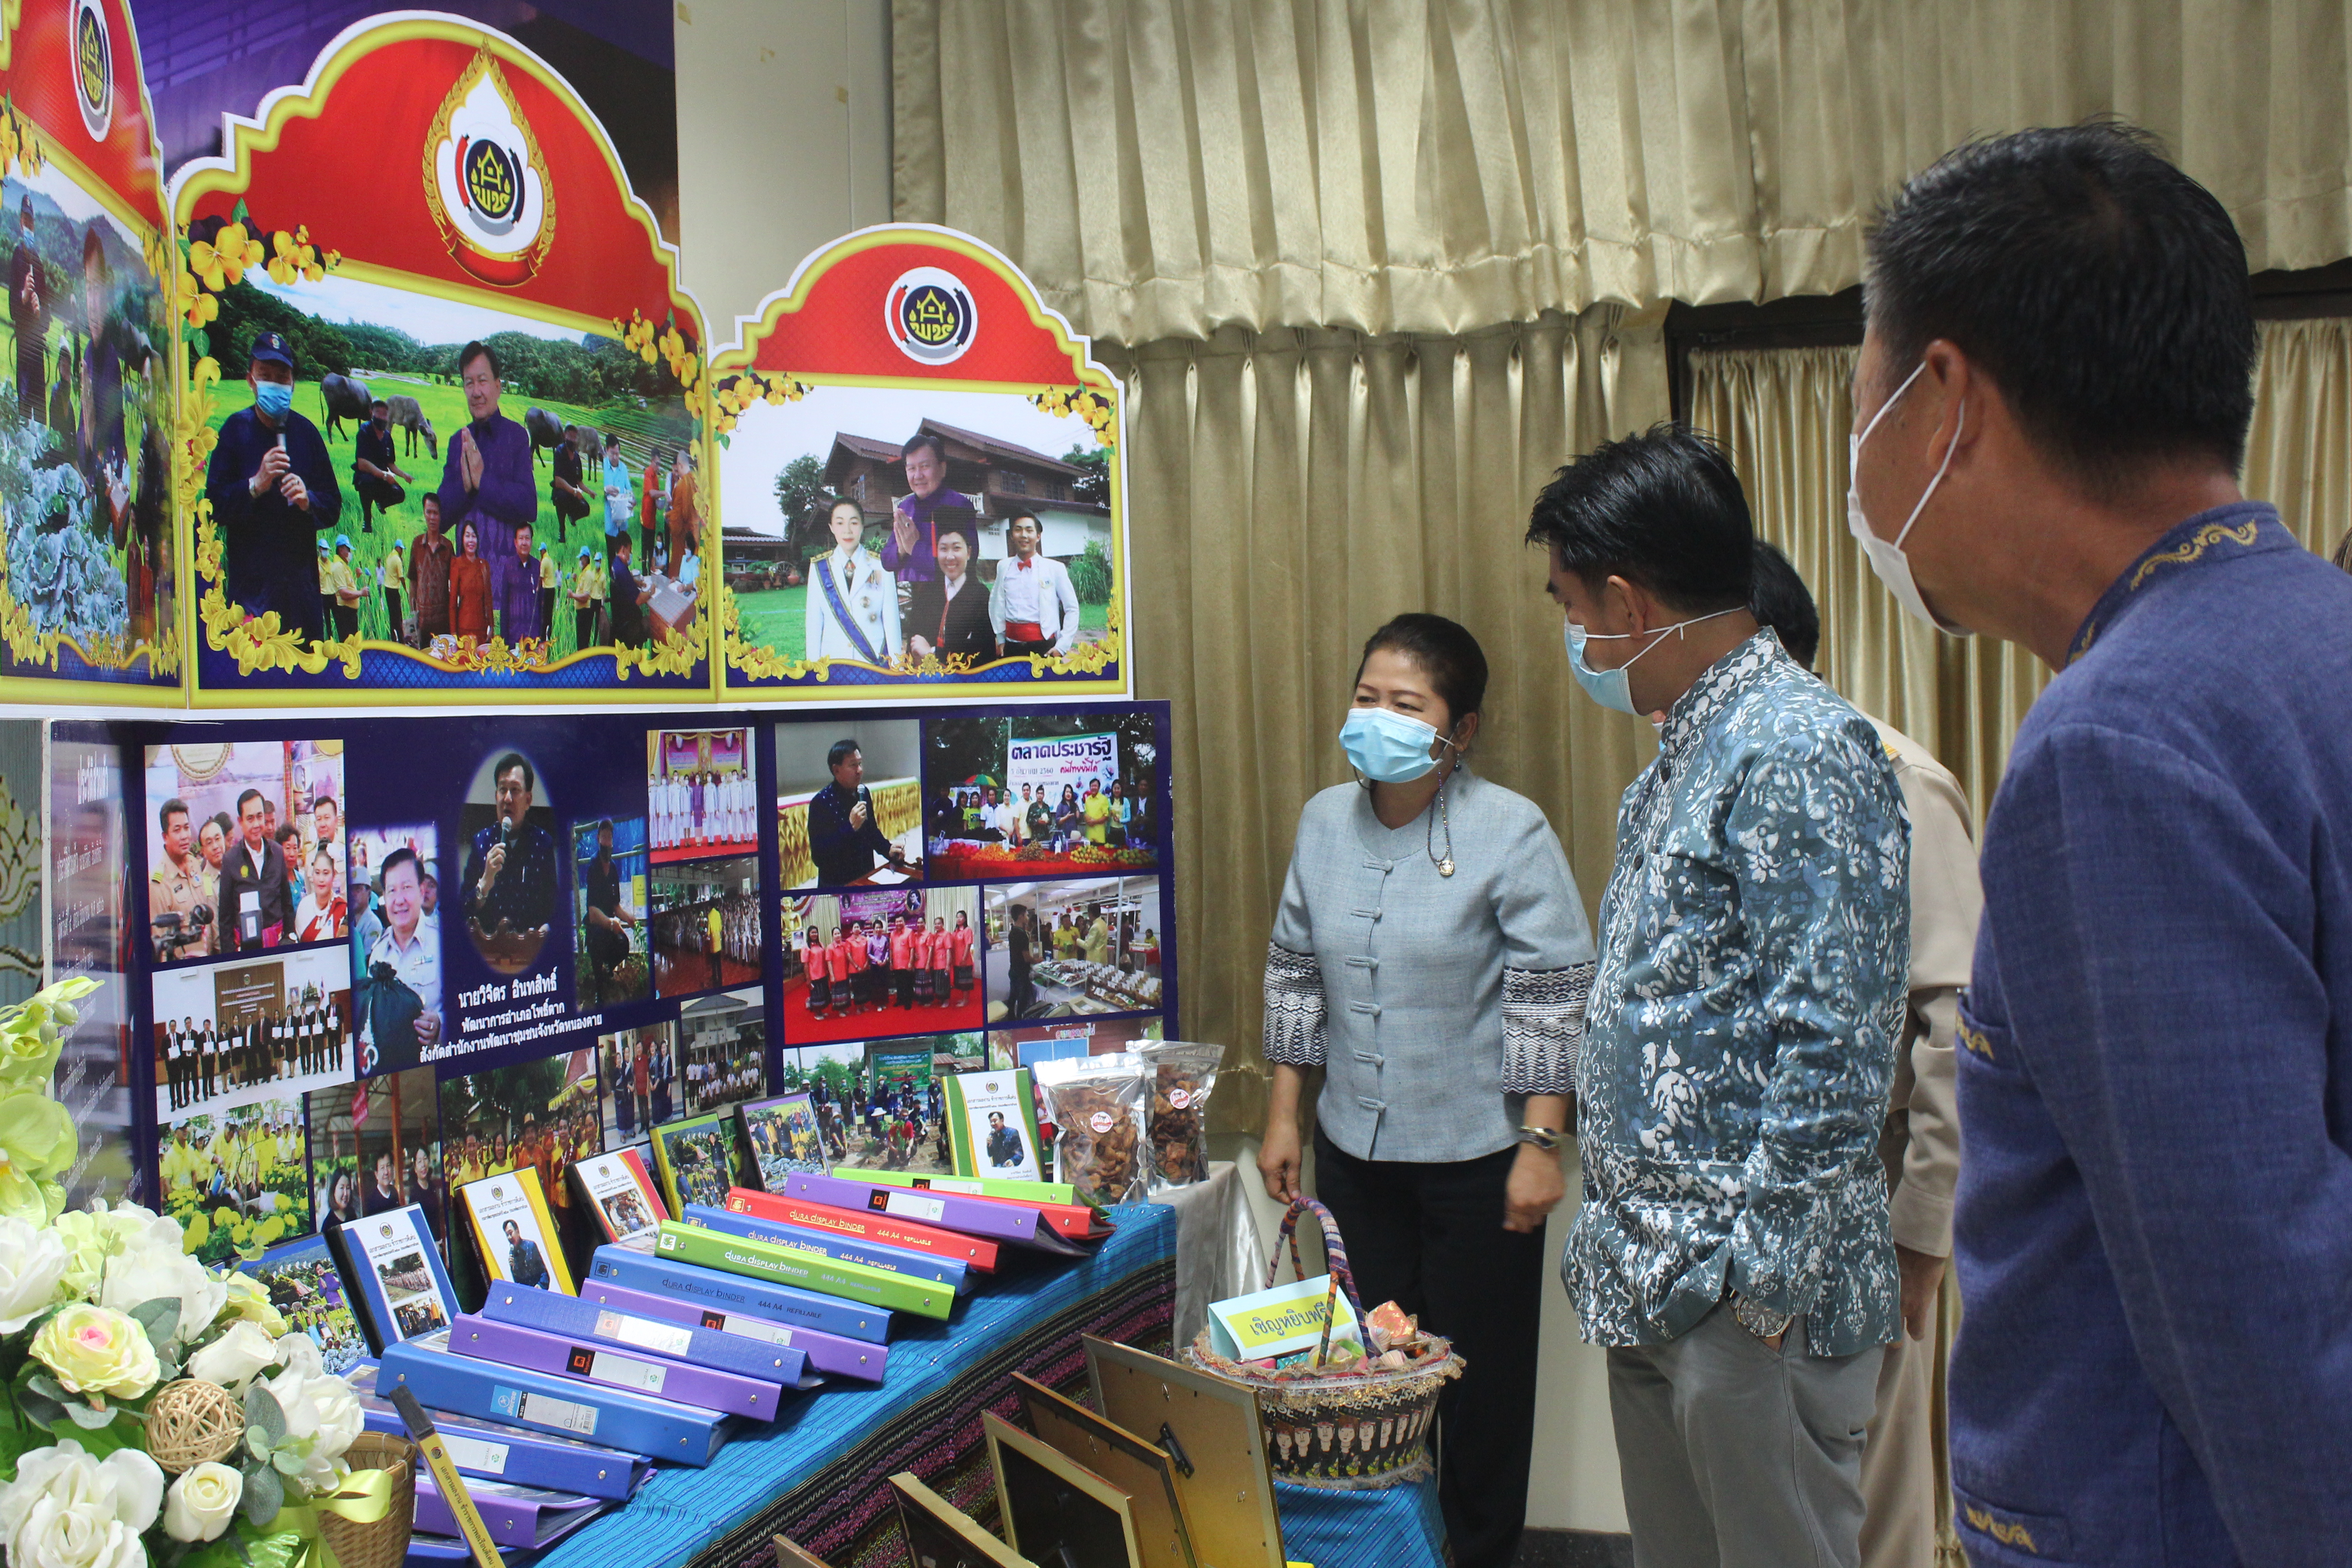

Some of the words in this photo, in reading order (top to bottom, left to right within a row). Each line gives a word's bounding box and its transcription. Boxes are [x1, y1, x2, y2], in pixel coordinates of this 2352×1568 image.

[1012, 736, 1111, 761] ตลาดประชารัฐ
[1060, 757, 1101, 774] คนไทยยิ้มได้
[458, 983, 506, 1008] นายวิจิตร
[512, 966, 558, 999] อินทสิทธิ์
[461, 998, 565, 1033] พัฒนาการอำเภอโพธิ์ตาก
[419, 1014, 603, 1063] สังกัดสำนักงานพัฒนาชุมชนจังหวัดหนองคาย
[786, 1307, 822, 1318] REFILLABLE
[441, 1466, 463, 1504] เอกสารผลงาน
